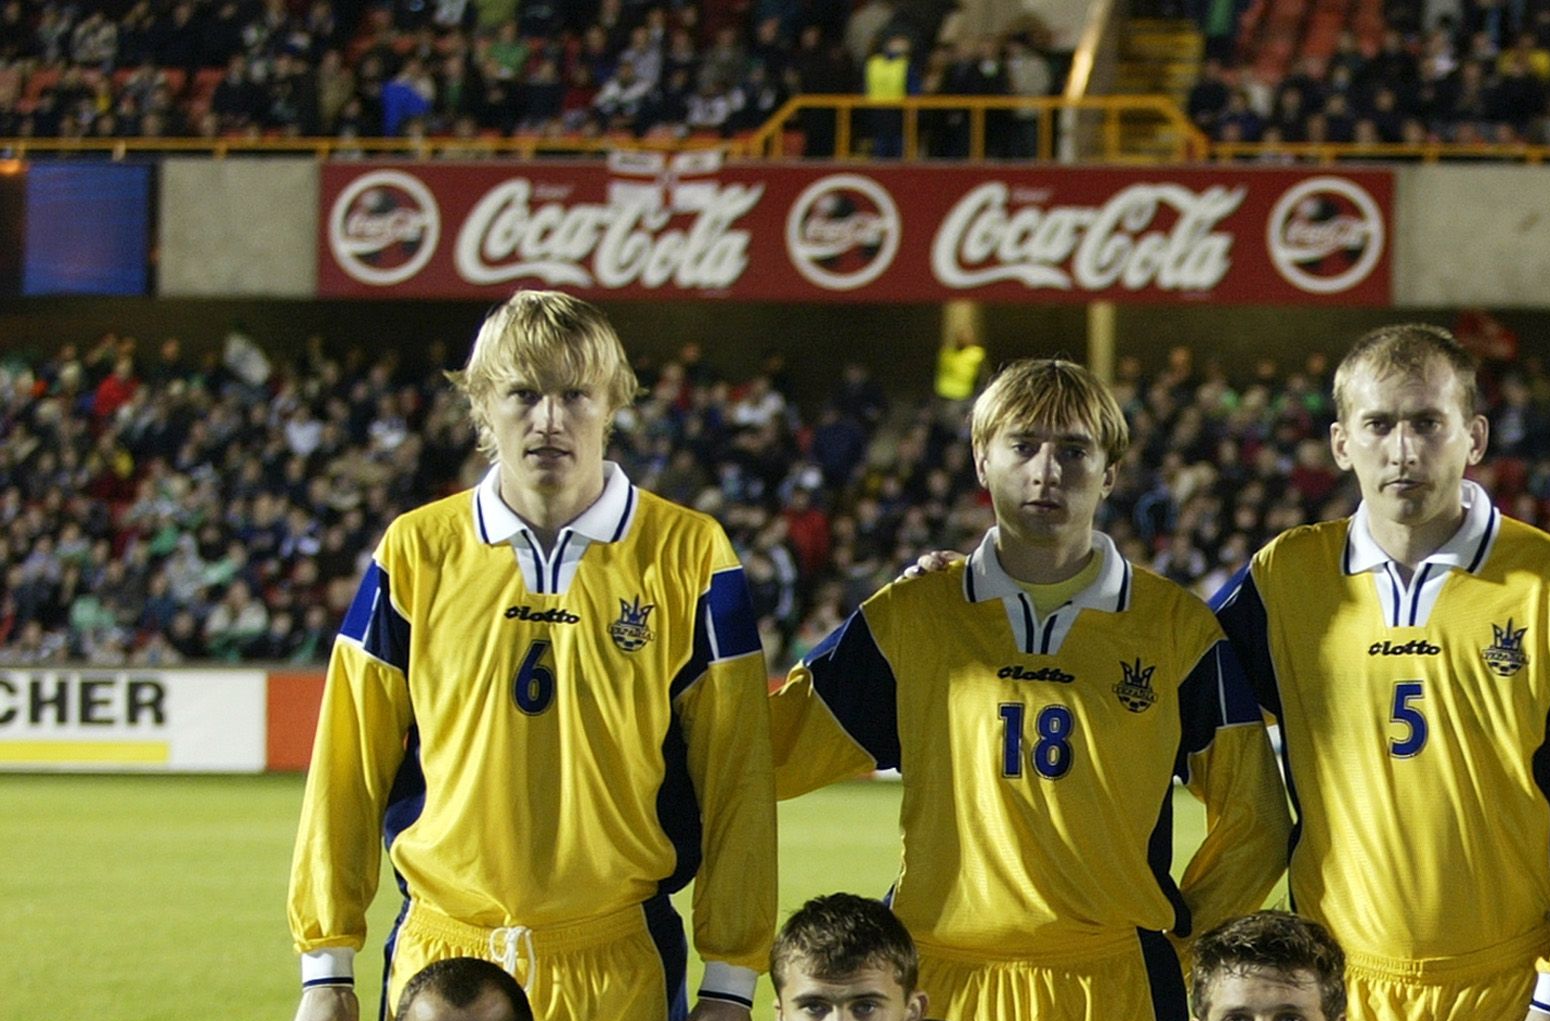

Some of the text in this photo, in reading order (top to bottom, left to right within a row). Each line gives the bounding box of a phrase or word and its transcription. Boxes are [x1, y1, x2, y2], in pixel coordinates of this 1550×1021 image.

[455, 178, 765, 288] Coca-Cola
[932, 181, 1247, 290] Coca-Cola
[520, 606, 580, 624] lotto
[1383, 640, 1441, 655] lotto
[513, 639, 555, 716] 6
[1013, 666, 1075, 683] lotto
[998, 703, 1074, 780] 18
[1389, 680, 1429, 760] 5
